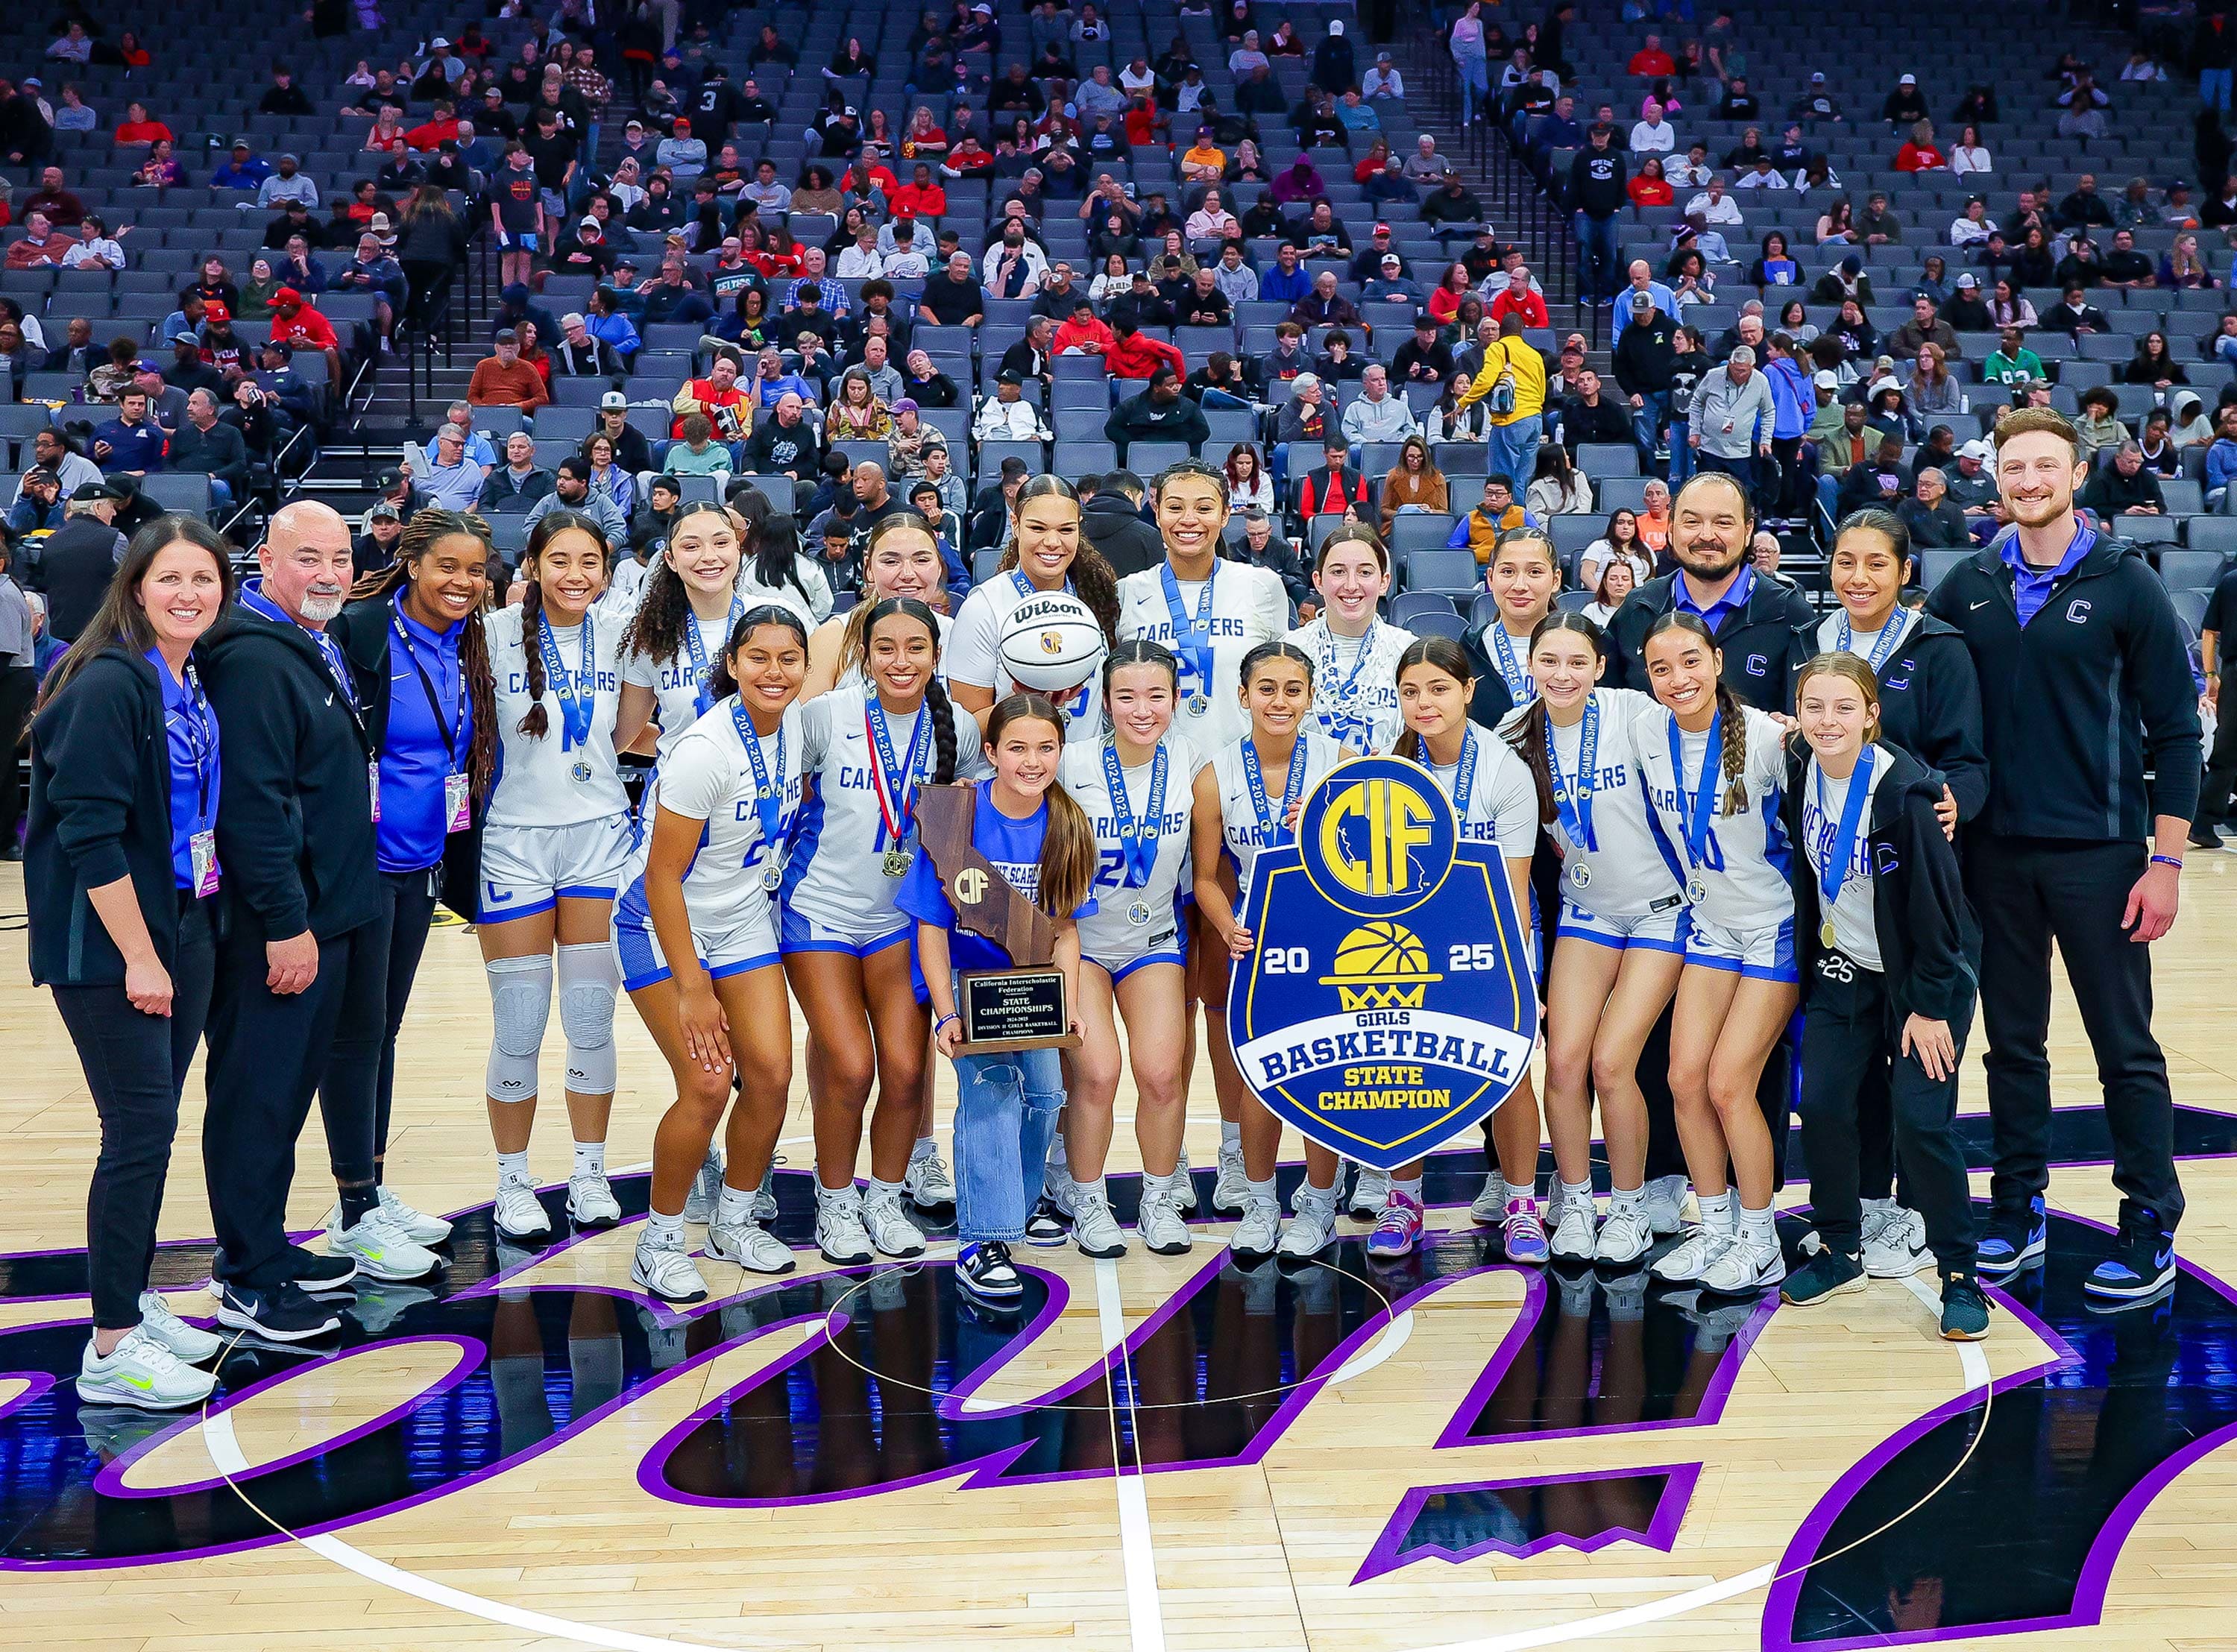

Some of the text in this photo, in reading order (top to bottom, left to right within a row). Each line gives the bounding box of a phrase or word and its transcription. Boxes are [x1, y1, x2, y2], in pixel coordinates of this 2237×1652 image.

[1013, 601, 1083, 623] Wilson
[2065, 599, 2092, 624] C
[538, 621, 564, 682] 2024-2025
[585, 616, 594, 678] CHAMPIONSHIPS
[686, 614, 705, 663] 024-2025
[1496, 630, 1520, 685] 2024-2025
[1746, 654, 1767, 677] C
[734, 714, 766, 781] 2024-2025
[869, 708, 896, 772] 2024-2025
[1581, 713, 1597, 779] CHAMPIONSHIPS
[572, 762, 592, 782] CIF
[1244, 750, 1267, 813] 2024-2025
[1456, 734, 1476, 801] CHAMPIONSHIPS
[1105, 754, 1129, 819] 2024-2025
[1149, 752, 1165, 819] CHAMPIONSHIPS
[1321, 779, 1433, 895] CIF
[761, 867, 780, 887] CIF
[954, 867, 990, 904] CIF
[1573, 864, 1589, 886] CIF
[1688, 880, 1706, 902] CIF
[1264, 944, 1494, 974] 20 25
[1816, 955, 1857, 983] #25
[974, 977, 1057, 988] California Interscholastic
[979, 1004, 1054, 1016] CHAMPIONSHIPS
[1002, 997, 1031, 1006] STATE
[1356, 1011, 1410, 1027] GIRLS
[1259, 1030, 1511, 1082] BASKETBALL
[1344, 1067, 1423, 1087] STATE
[1318, 1089, 1451, 1111] CHAMPION
